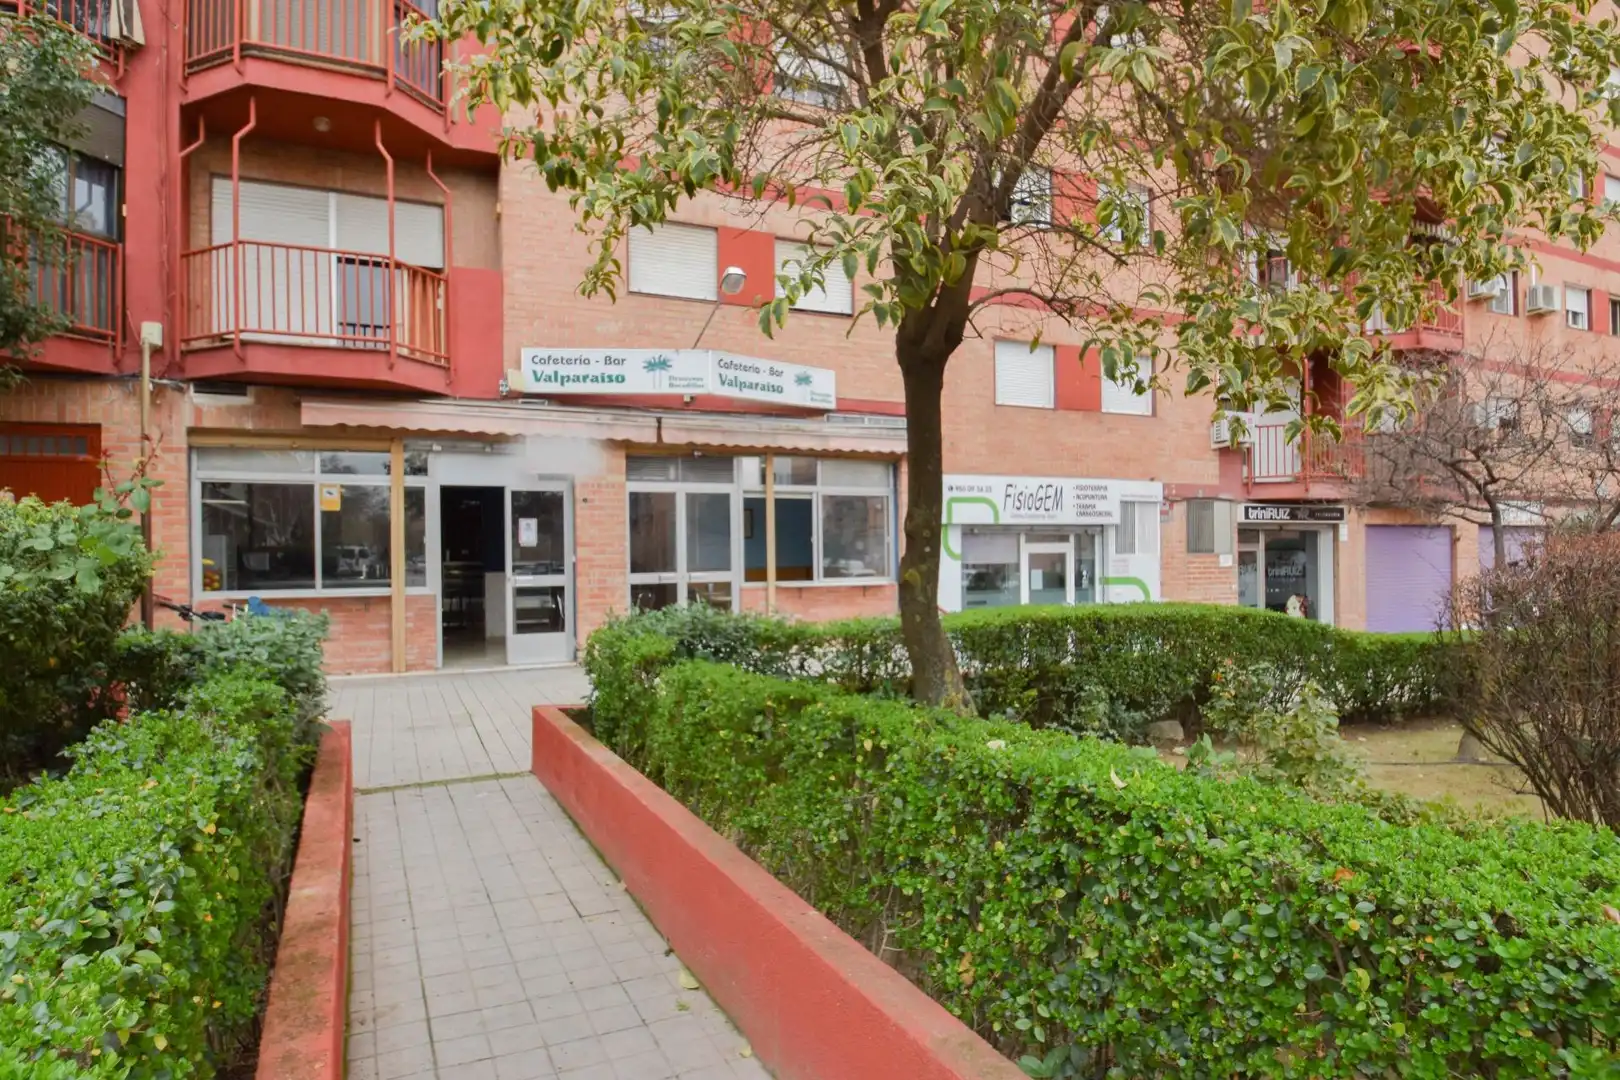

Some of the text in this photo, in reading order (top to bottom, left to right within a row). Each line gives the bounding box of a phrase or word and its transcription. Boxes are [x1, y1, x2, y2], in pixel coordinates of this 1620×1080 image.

[531, 354, 591, 366] Cafetería
[604, 355, 627, 366] Bar
[532, 369, 626, 386] Valparaiso
[768, 367, 784, 378] Bar
[718, 373, 784, 394] Valparaiso
[1003, 483, 1063, 512] FisioGEM
[1248, 507, 1290, 520] triniRUIZ
